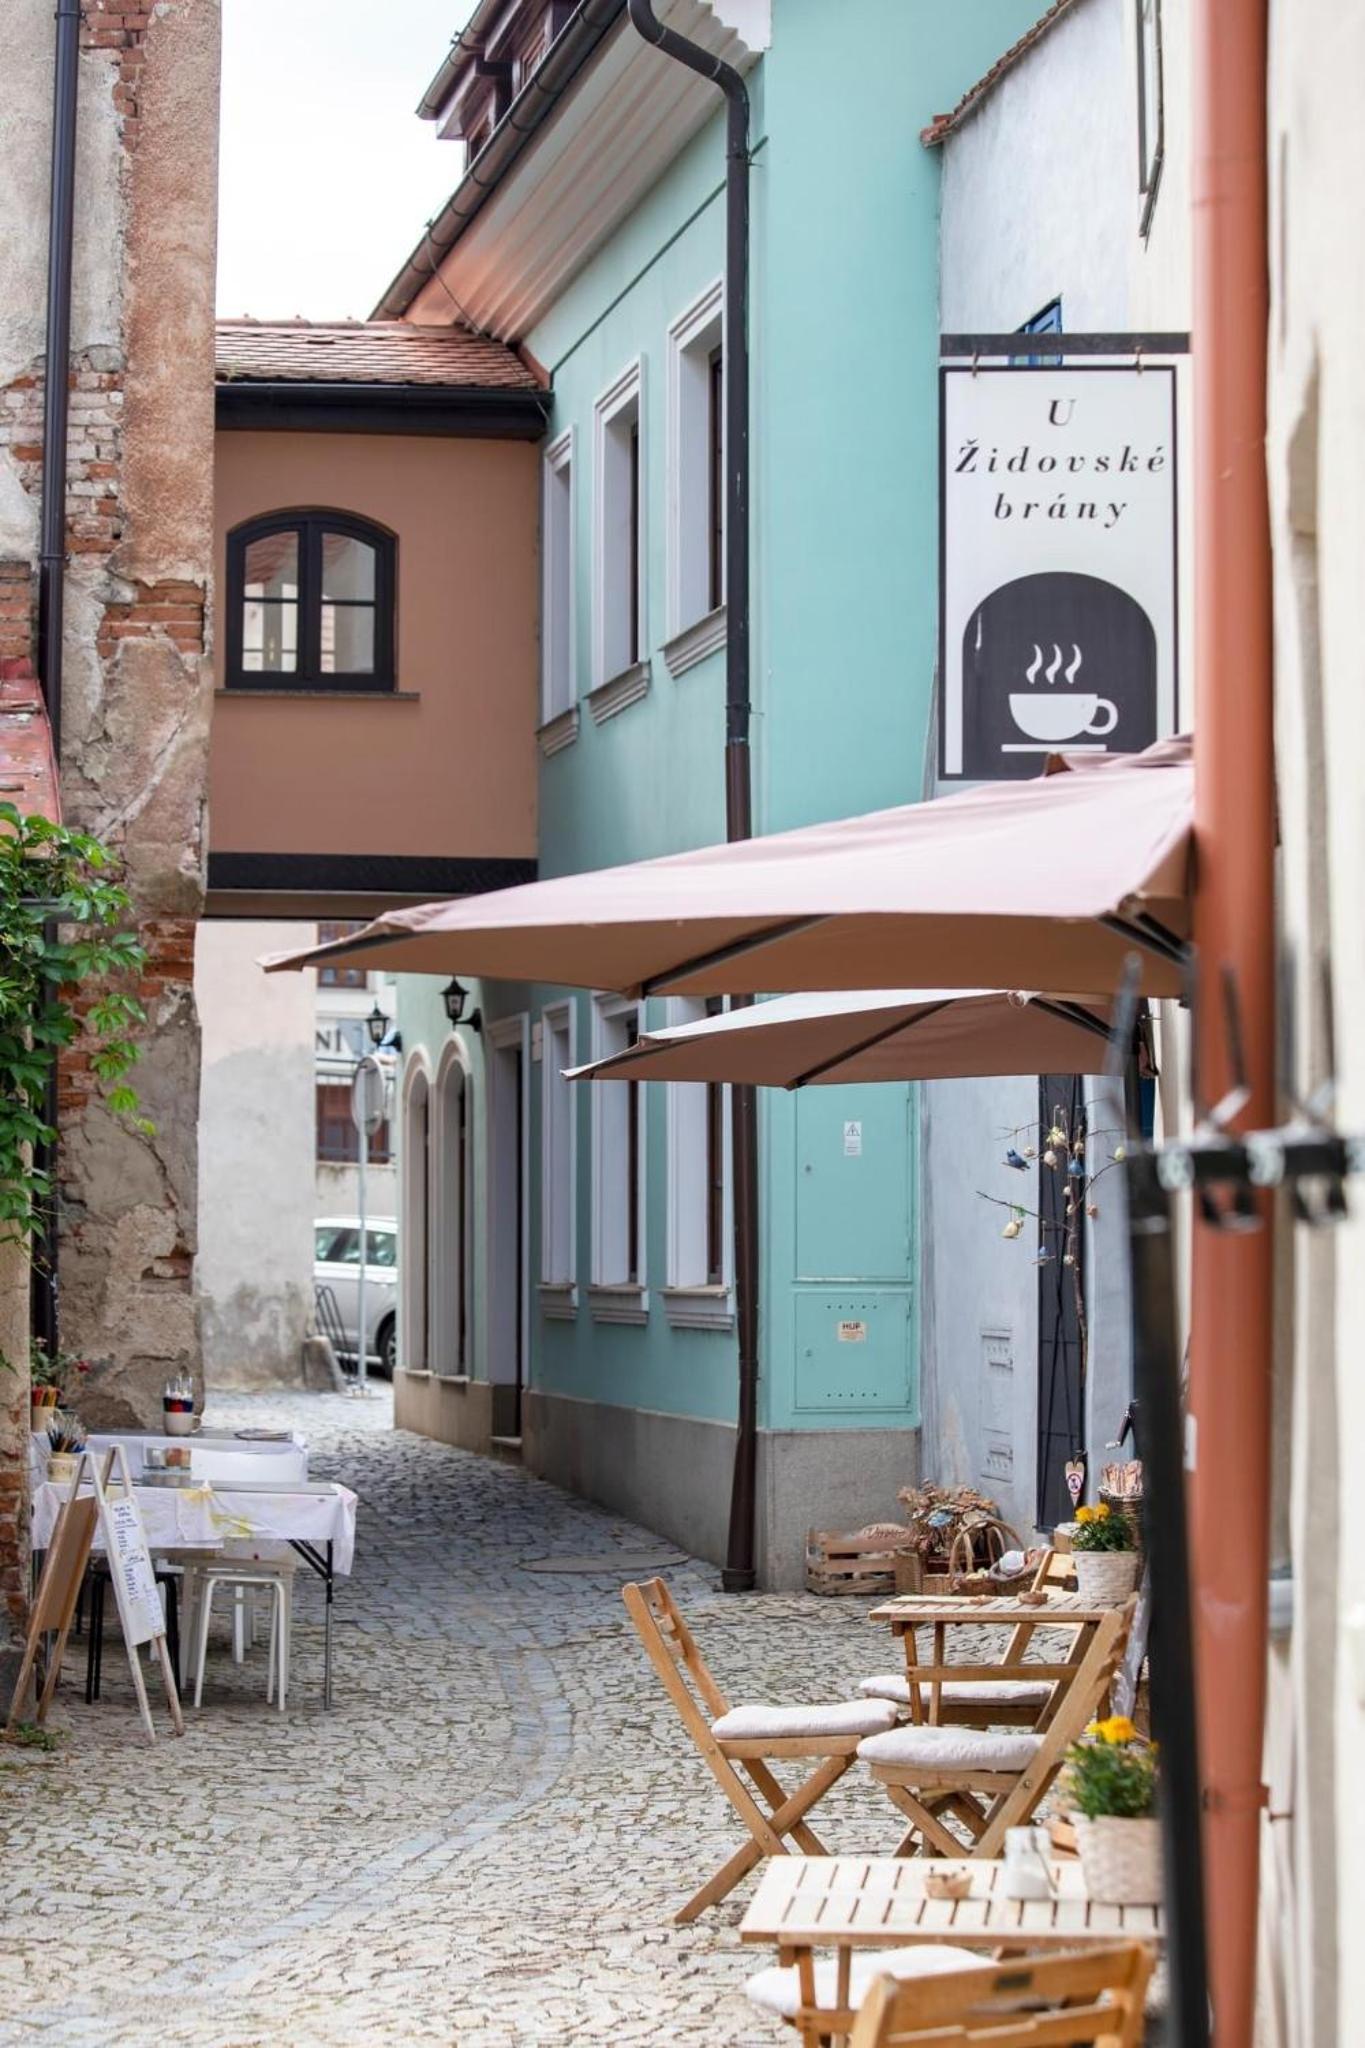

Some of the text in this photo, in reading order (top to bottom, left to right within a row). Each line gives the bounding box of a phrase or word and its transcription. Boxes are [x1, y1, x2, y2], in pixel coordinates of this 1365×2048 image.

[1048, 399, 1076, 426] U
[954, 438, 1165, 473] Židovské
[994, 492, 1127, 528] brány
